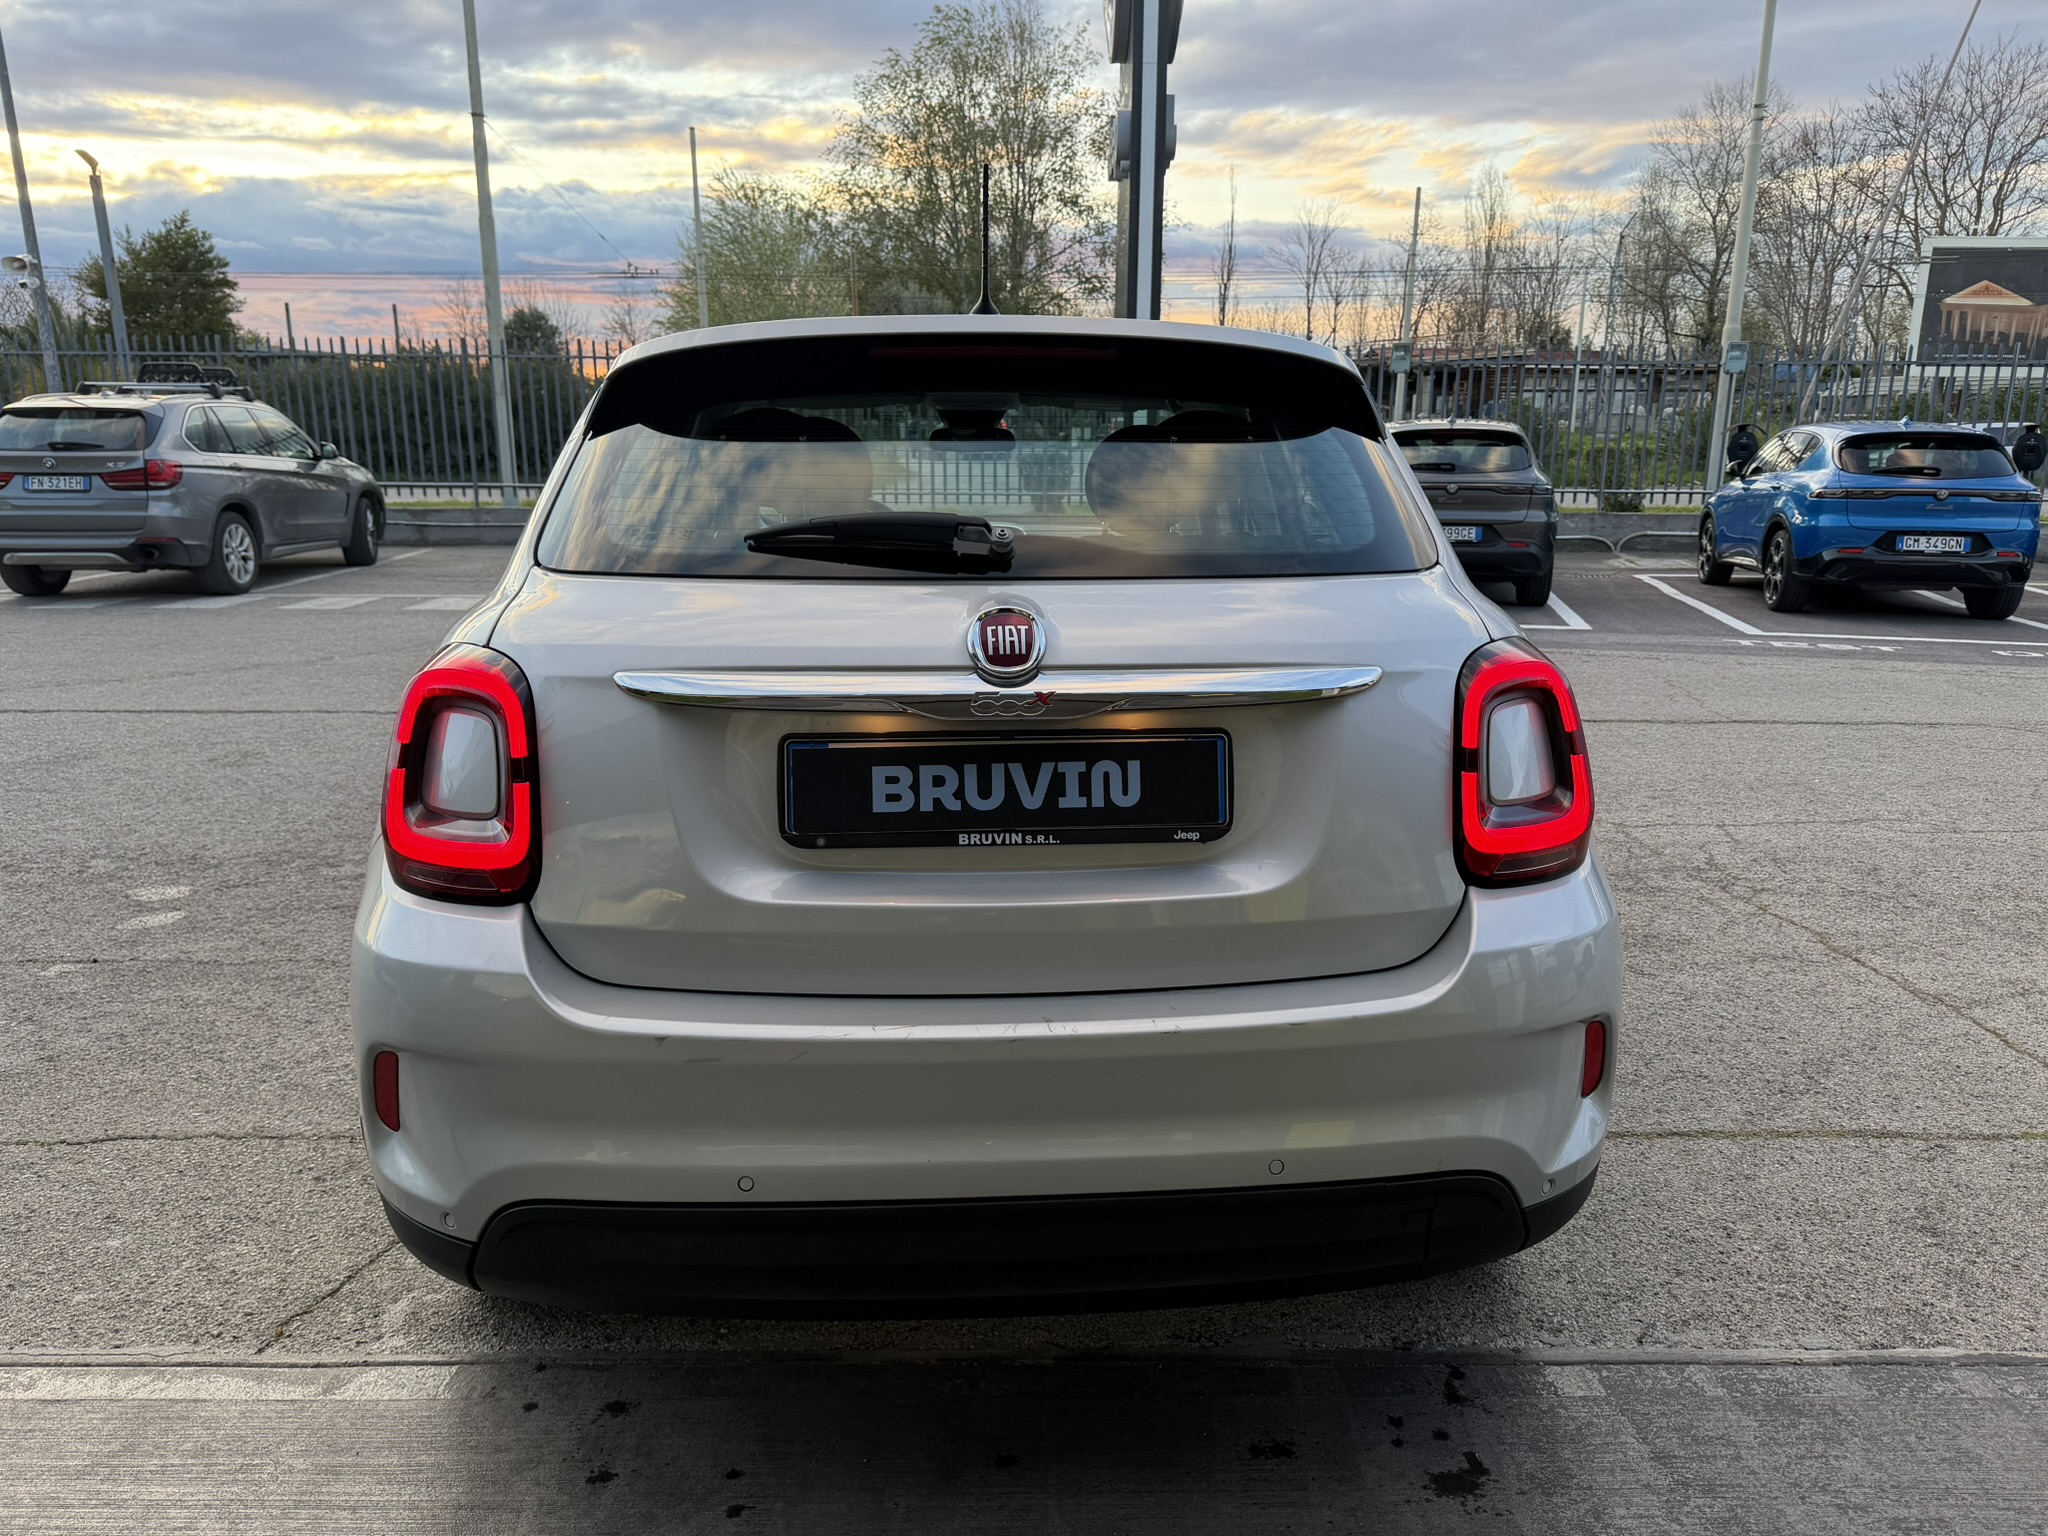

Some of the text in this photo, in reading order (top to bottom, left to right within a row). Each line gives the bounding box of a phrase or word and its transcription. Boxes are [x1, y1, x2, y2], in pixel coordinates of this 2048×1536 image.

[47, 476, 82, 489] 321EH
[1924, 537, 1963, 550] 349GN
[986, 625, 1029, 655] FIAT
[872, 759, 1142, 813] BRUVIN
[958, 832, 1060, 845] BRUVIN S.R.L.
[1173, 830, 1200, 841] Jeep
